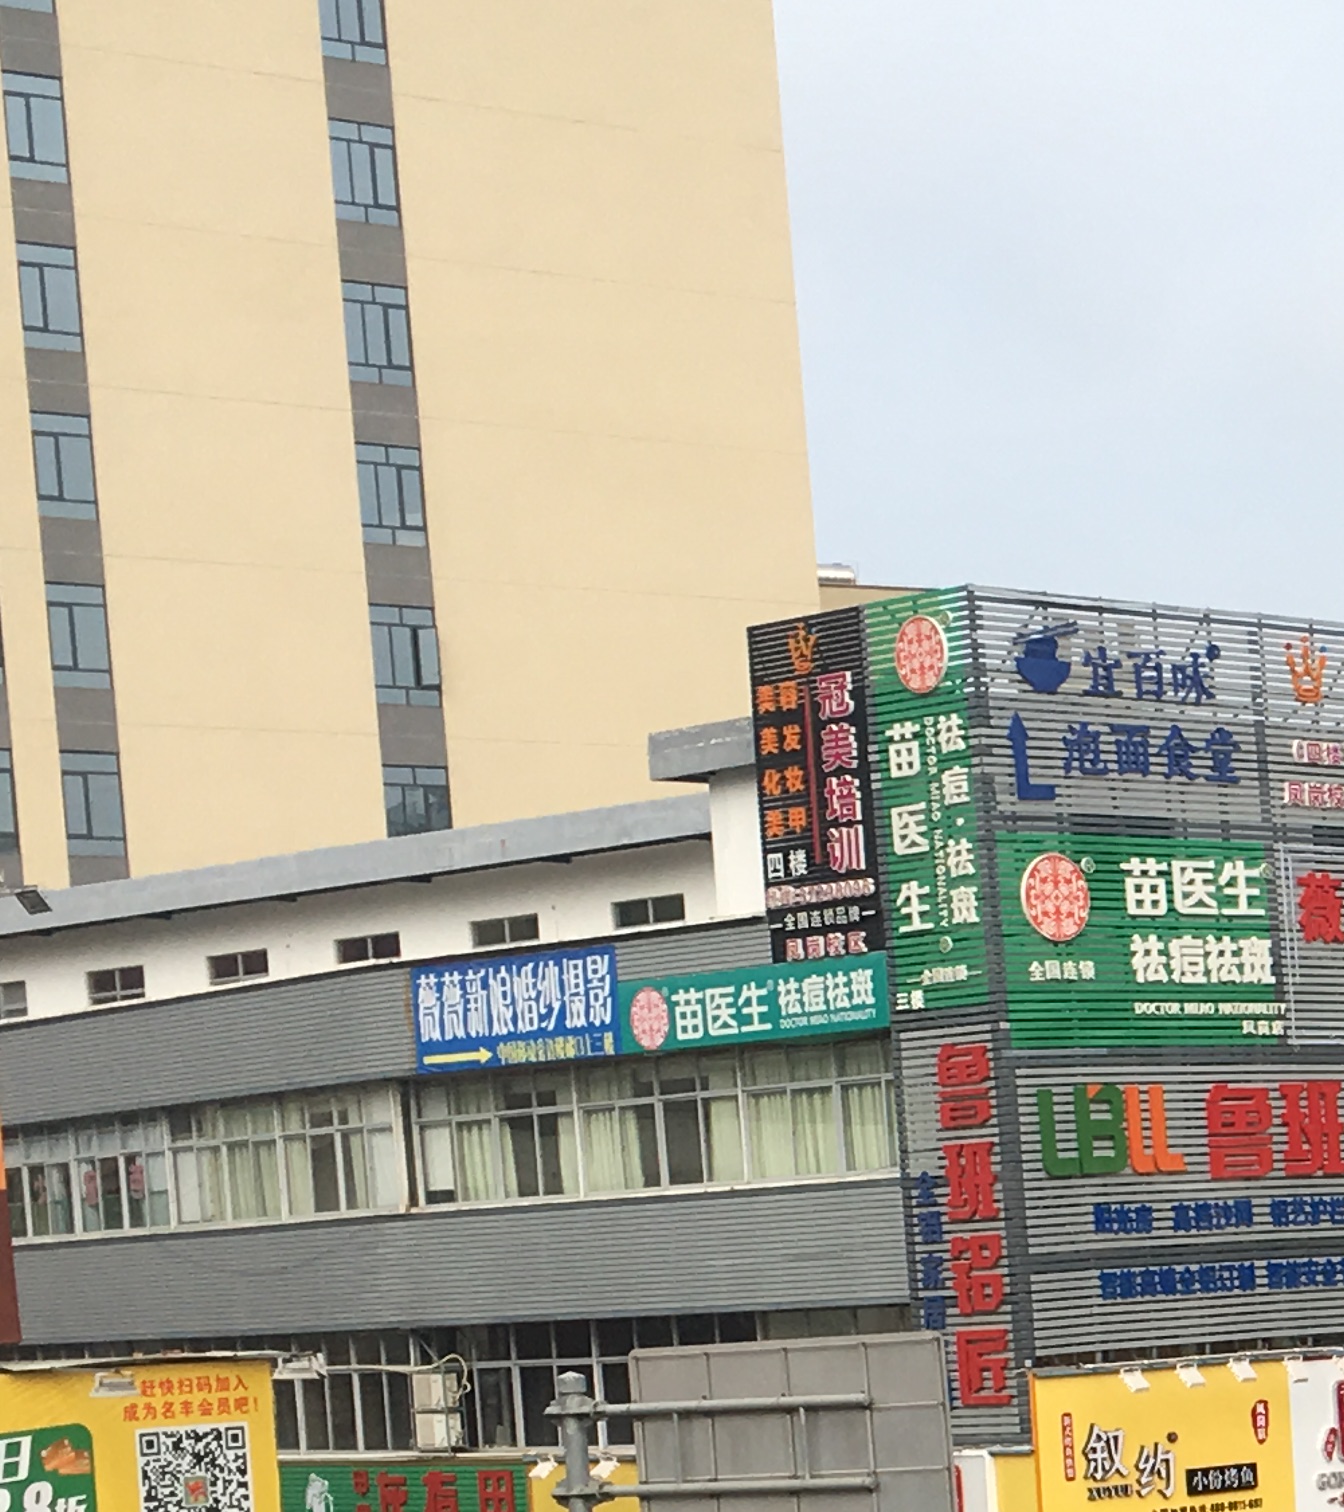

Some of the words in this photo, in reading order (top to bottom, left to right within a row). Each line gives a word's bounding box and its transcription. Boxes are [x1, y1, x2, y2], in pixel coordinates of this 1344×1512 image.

[757, 681, 799, 713] 美容
[760, 724, 801, 755] 美发
[923, 717, 938, 775] DOCTOR
[763, 766, 805, 796] 化妆
[815, 671, 866, 873] 冠美培训
[766, 807, 807, 838] 美甲
[929, 782, 942, 822] MIAO
[885, 721, 934, 932] 苗医生
[767, 850, 808, 879] 四楼
[933, 829, 949, 927] NATIONALITY
[1119, 858, 1265, 916] 苗医生
[1028, 960, 1095, 981] 全国连锁
[1130, 934, 1277, 984] 祛痘祛斑
[671, 982, 772, 1041] 苗医生
[778, 968, 875, 1016] 祛痘祛斑
[936, 1043, 1012, 1406] 鲁班铝匠
[140, 1374, 249, 1397] 赶快扫码加入
[1083, 1423, 1176, 1499] 叙约
[1192, 1466, 1255, 1492] 小份烤鱼
